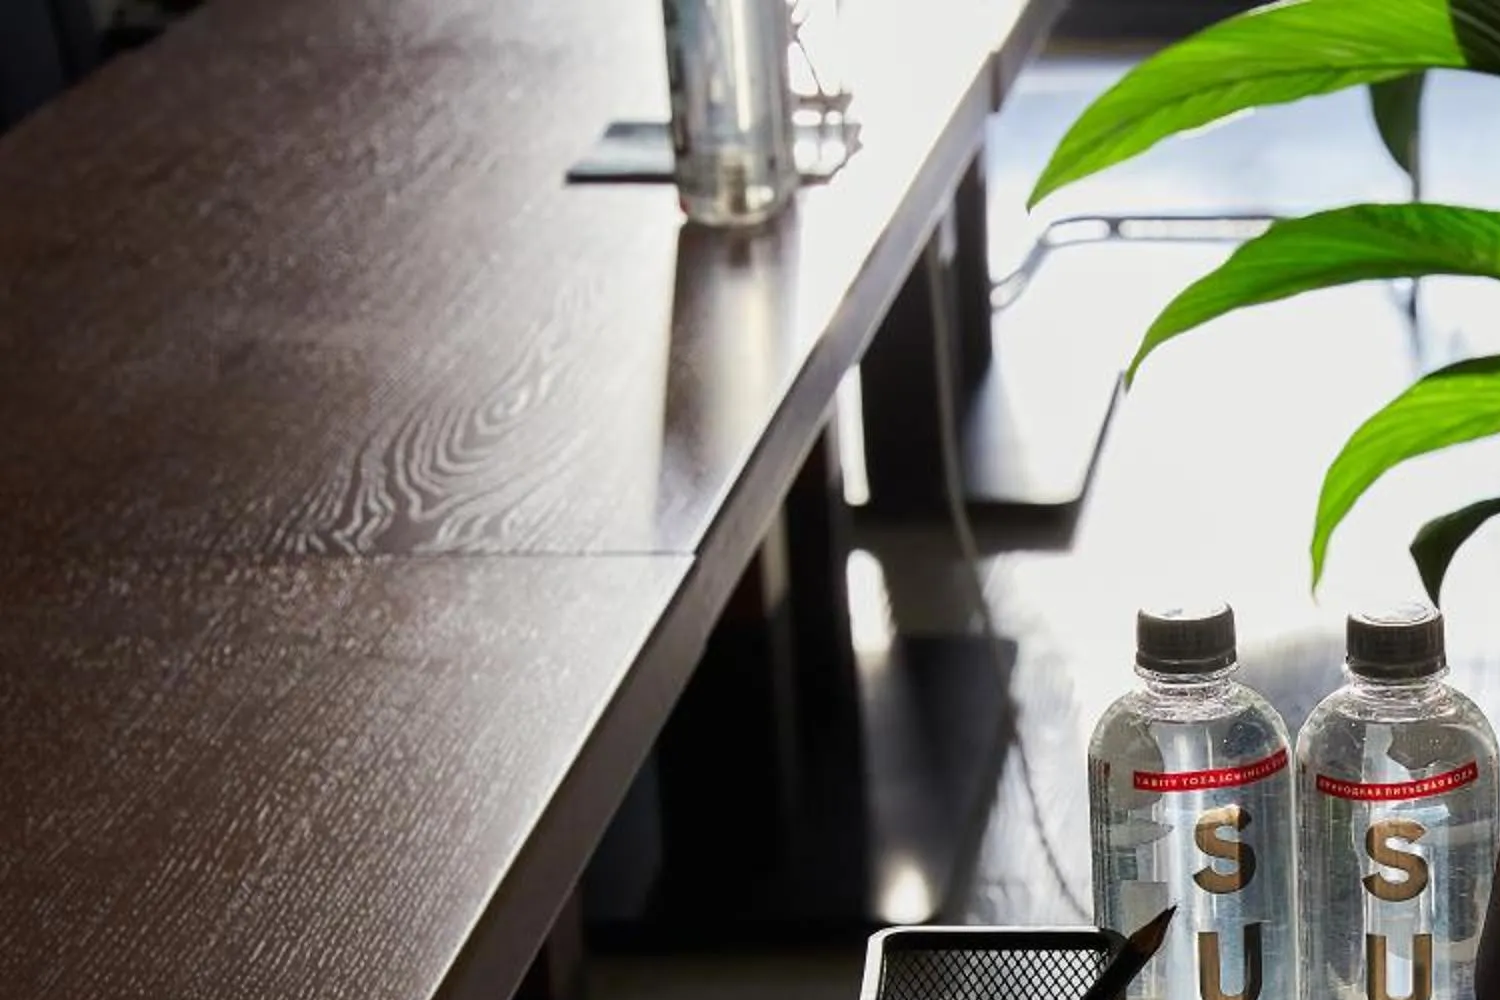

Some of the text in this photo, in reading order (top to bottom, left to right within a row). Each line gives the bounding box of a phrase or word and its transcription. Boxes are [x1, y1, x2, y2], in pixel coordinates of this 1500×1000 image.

[1181, 774, 1216, 786] TOZA
[1385, 780, 1445, 797] ПИТЬЕВАЯ
[1446, 768, 1474, 786] ВОДА
